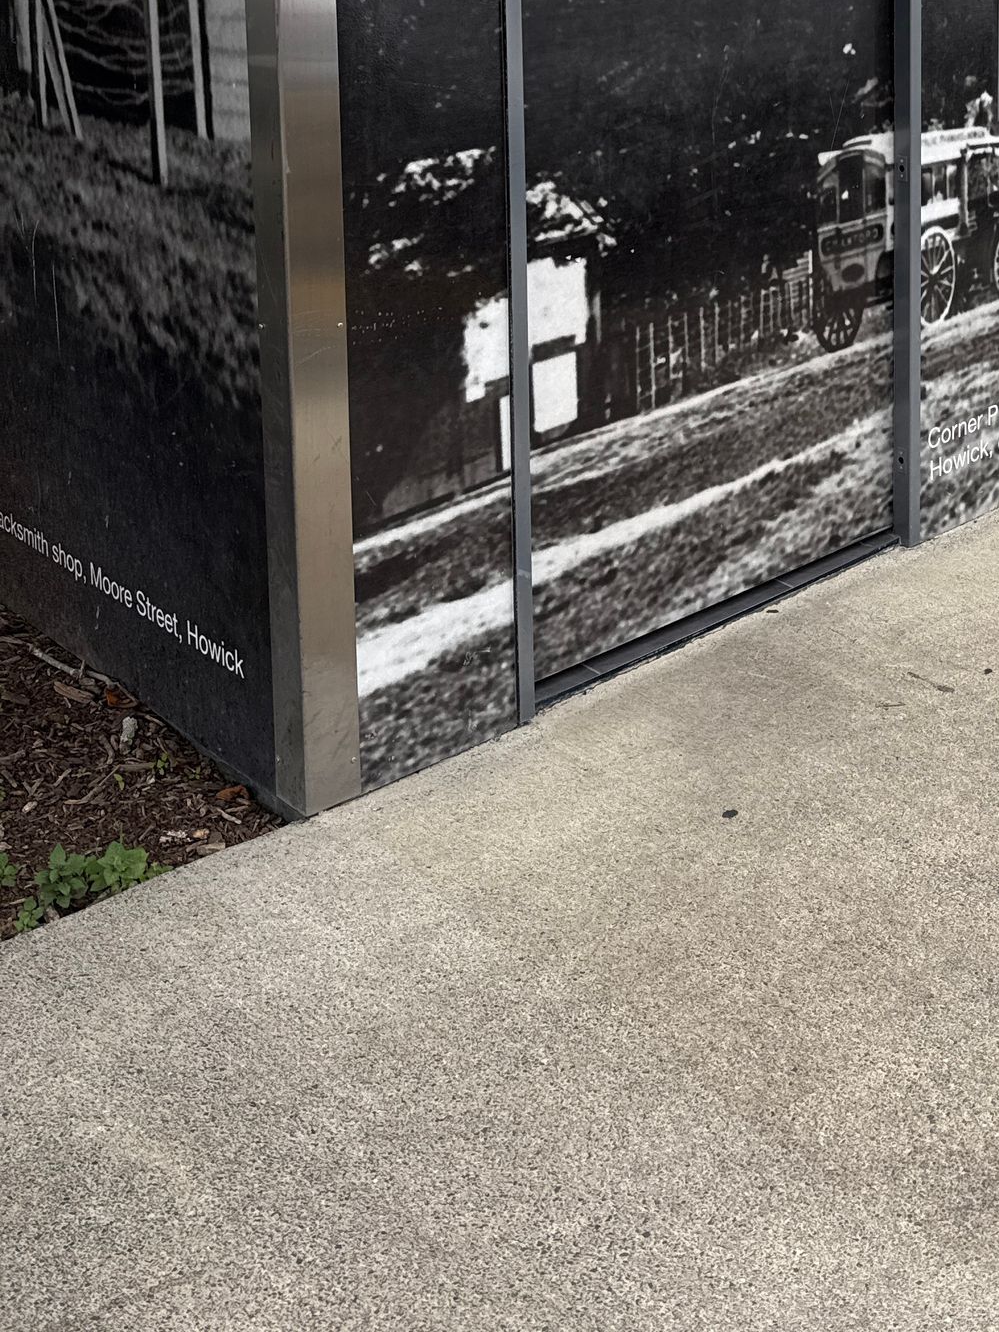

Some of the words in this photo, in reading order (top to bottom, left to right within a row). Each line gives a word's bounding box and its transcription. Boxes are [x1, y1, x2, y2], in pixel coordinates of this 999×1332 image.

[928, 410, 983, 449] Corner
[929, 440, 993, 480] Howick,
[52, 543, 87, 584] shop,
[90, 562, 133, 608] Moore
[136, 590, 183, 644] Street,
[187, 620, 245, 679] Howick
